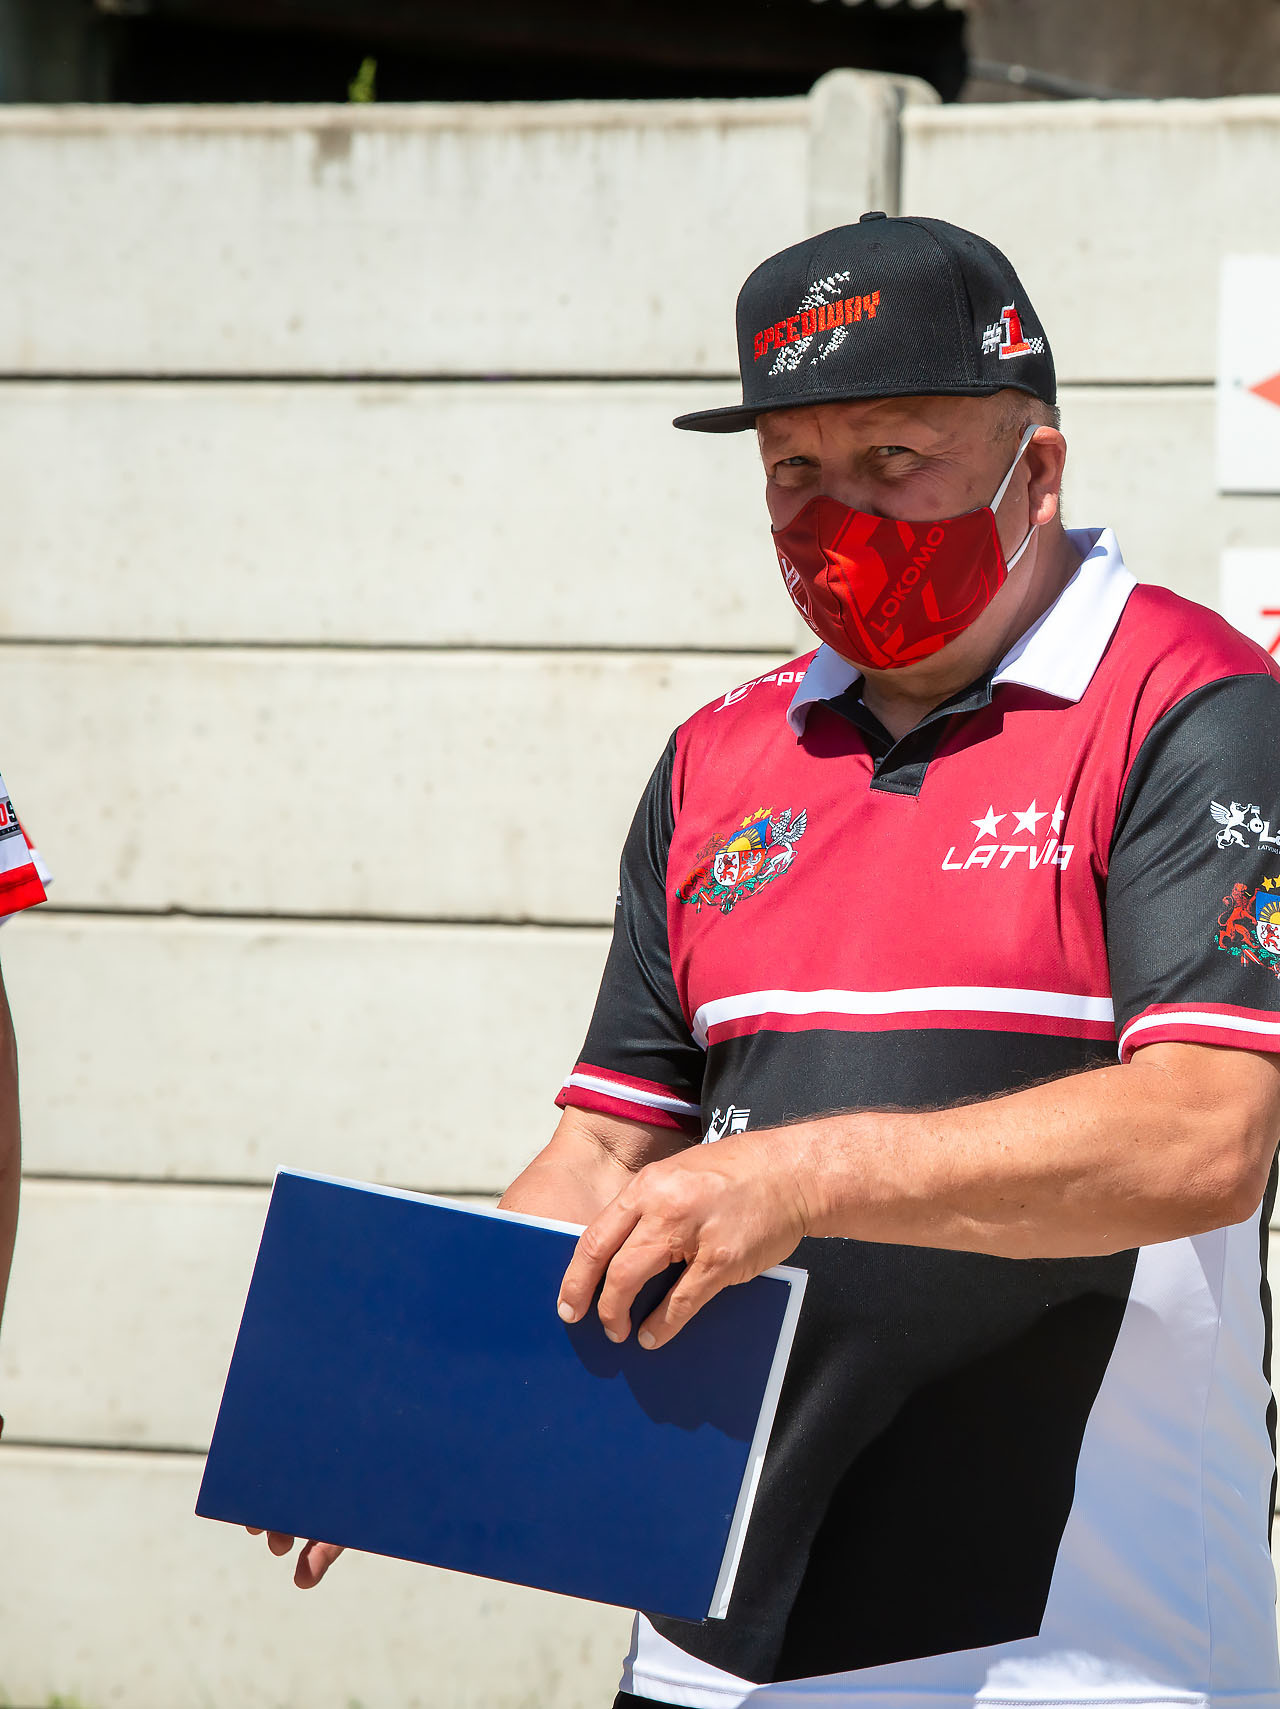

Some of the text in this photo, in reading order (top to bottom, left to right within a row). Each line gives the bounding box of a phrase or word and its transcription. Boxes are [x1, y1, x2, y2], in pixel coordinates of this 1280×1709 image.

[754, 290, 881, 362] SPEEDWAY
[870, 520, 951, 632] LOKOMO
[942, 839, 1075, 870] LATVIA
